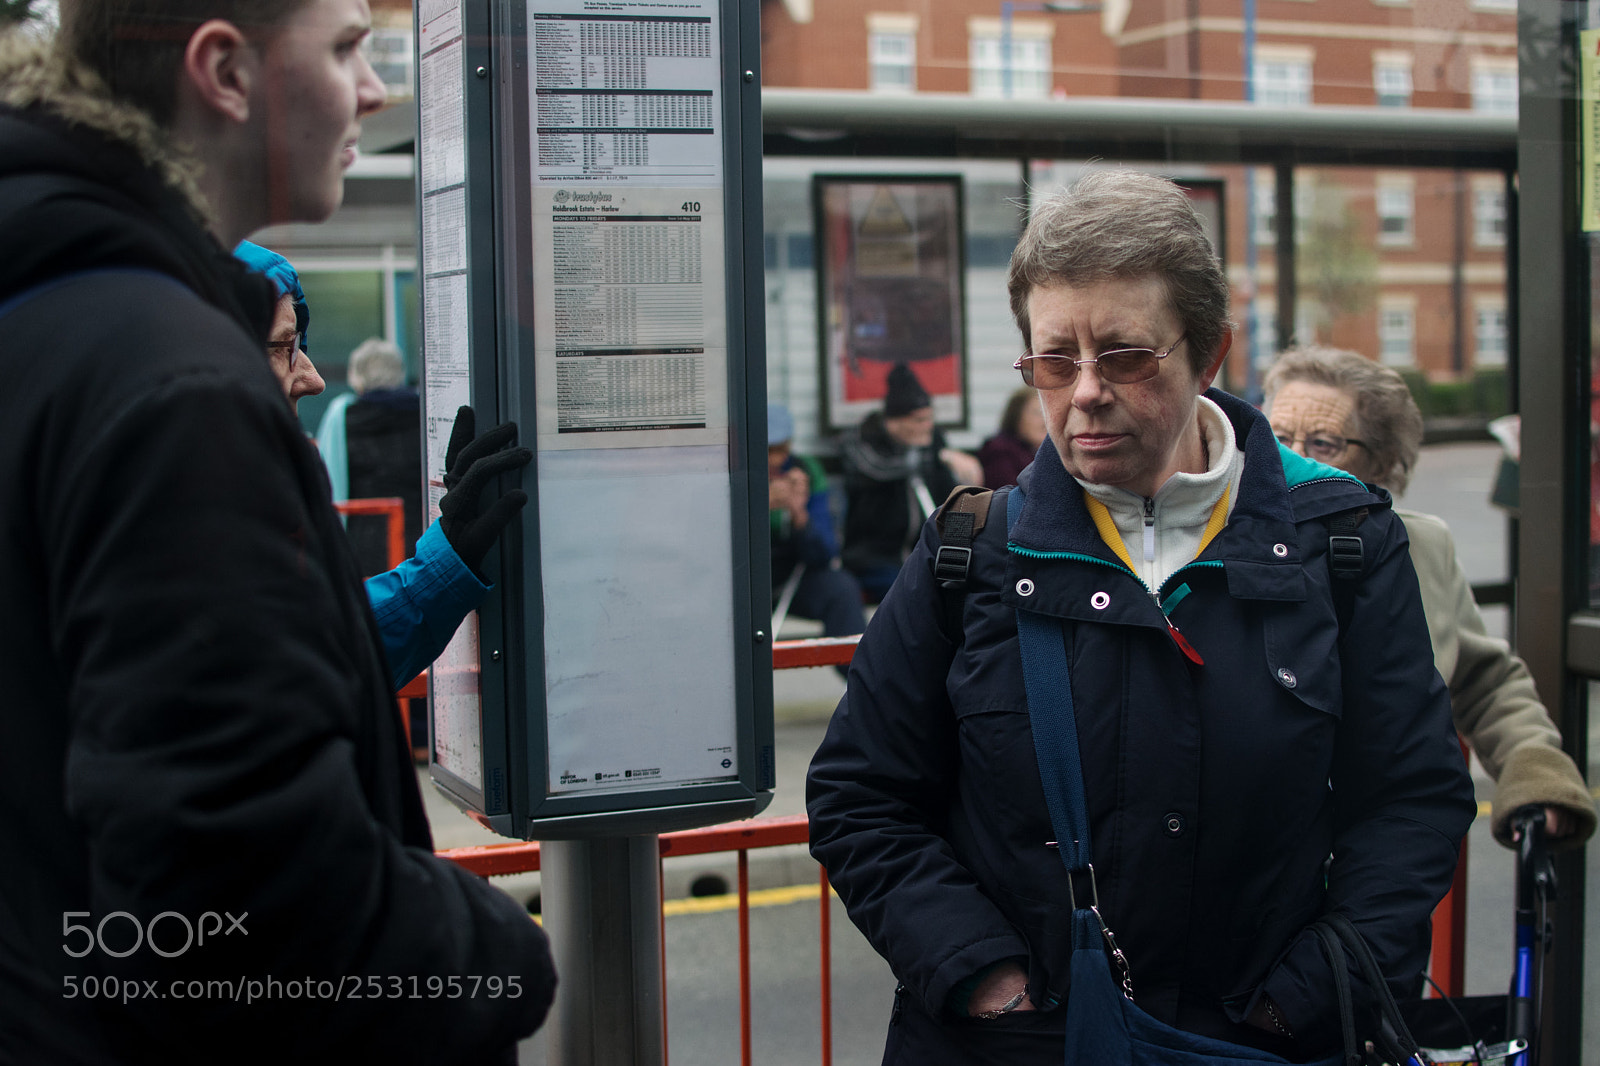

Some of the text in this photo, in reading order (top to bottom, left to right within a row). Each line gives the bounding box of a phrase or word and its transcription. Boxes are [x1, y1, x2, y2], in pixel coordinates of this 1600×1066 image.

[553, 204, 578, 212] Holdbrook
[601, 204, 619, 212] Harlow
[681, 201, 701, 213] 410
